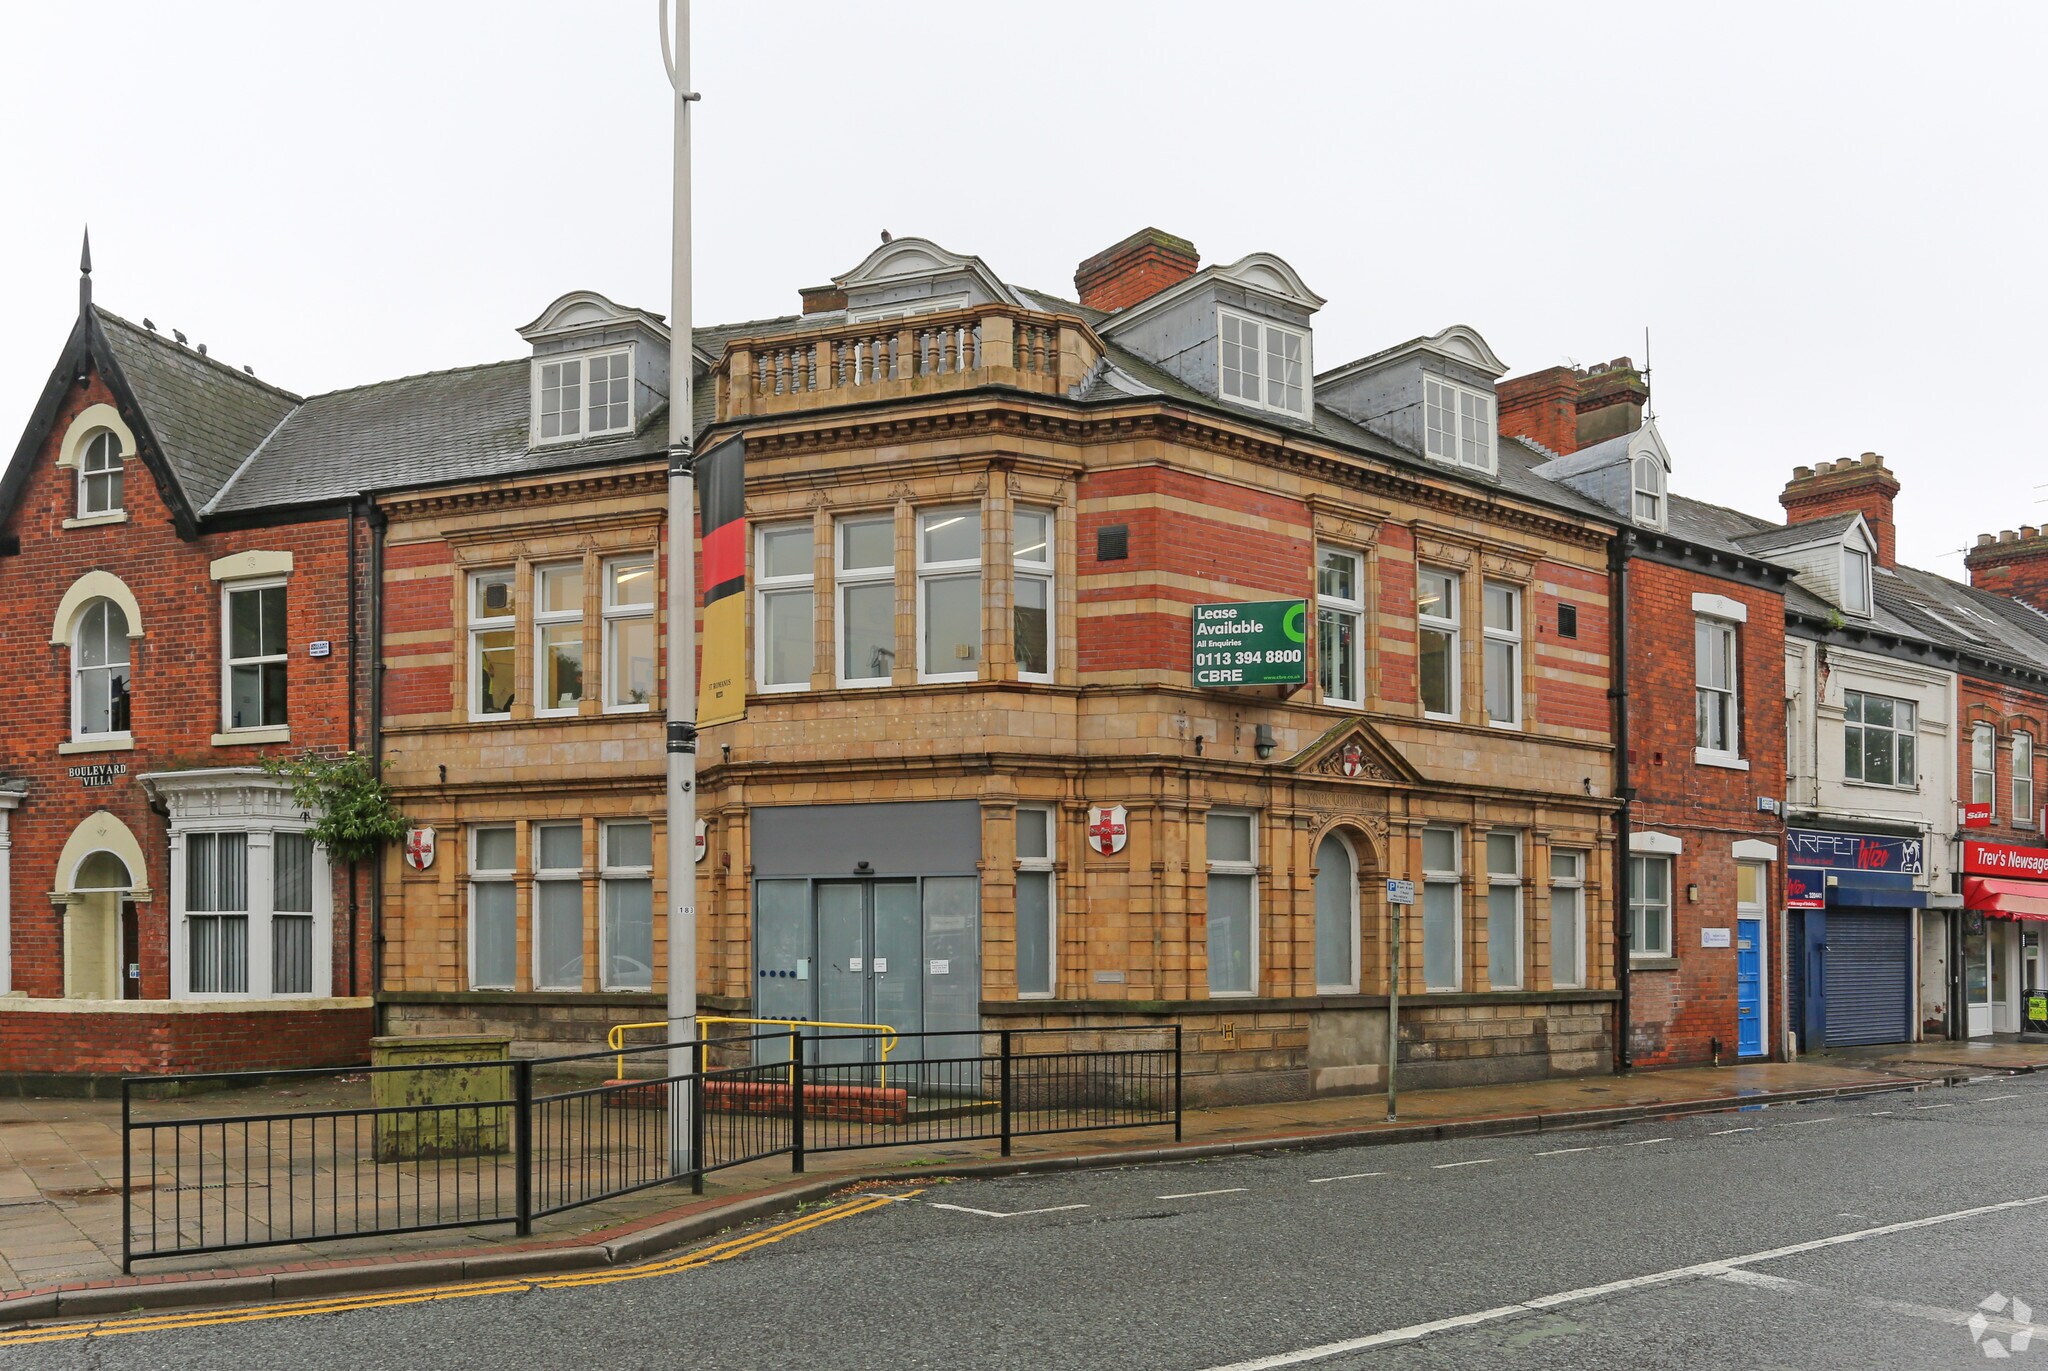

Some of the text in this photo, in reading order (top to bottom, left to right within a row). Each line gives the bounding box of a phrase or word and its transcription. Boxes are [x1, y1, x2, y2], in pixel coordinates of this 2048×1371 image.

[1197, 608, 1238, 619] Lease
[1196, 620, 1264, 635] Available
[1197, 639, 1242, 648] All Enquiries
[1196, 650, 1301, 666] 0113 394 8800
[1197, 669, 1243, 683] CBRE
[69, 764, 126, 777] BOULEVARD
[84, 776, 112, 786] VILLA
[1306, 791, 1386, 810] YORK UNION BANK
[1977, 847, 2006, 867] Trev's
